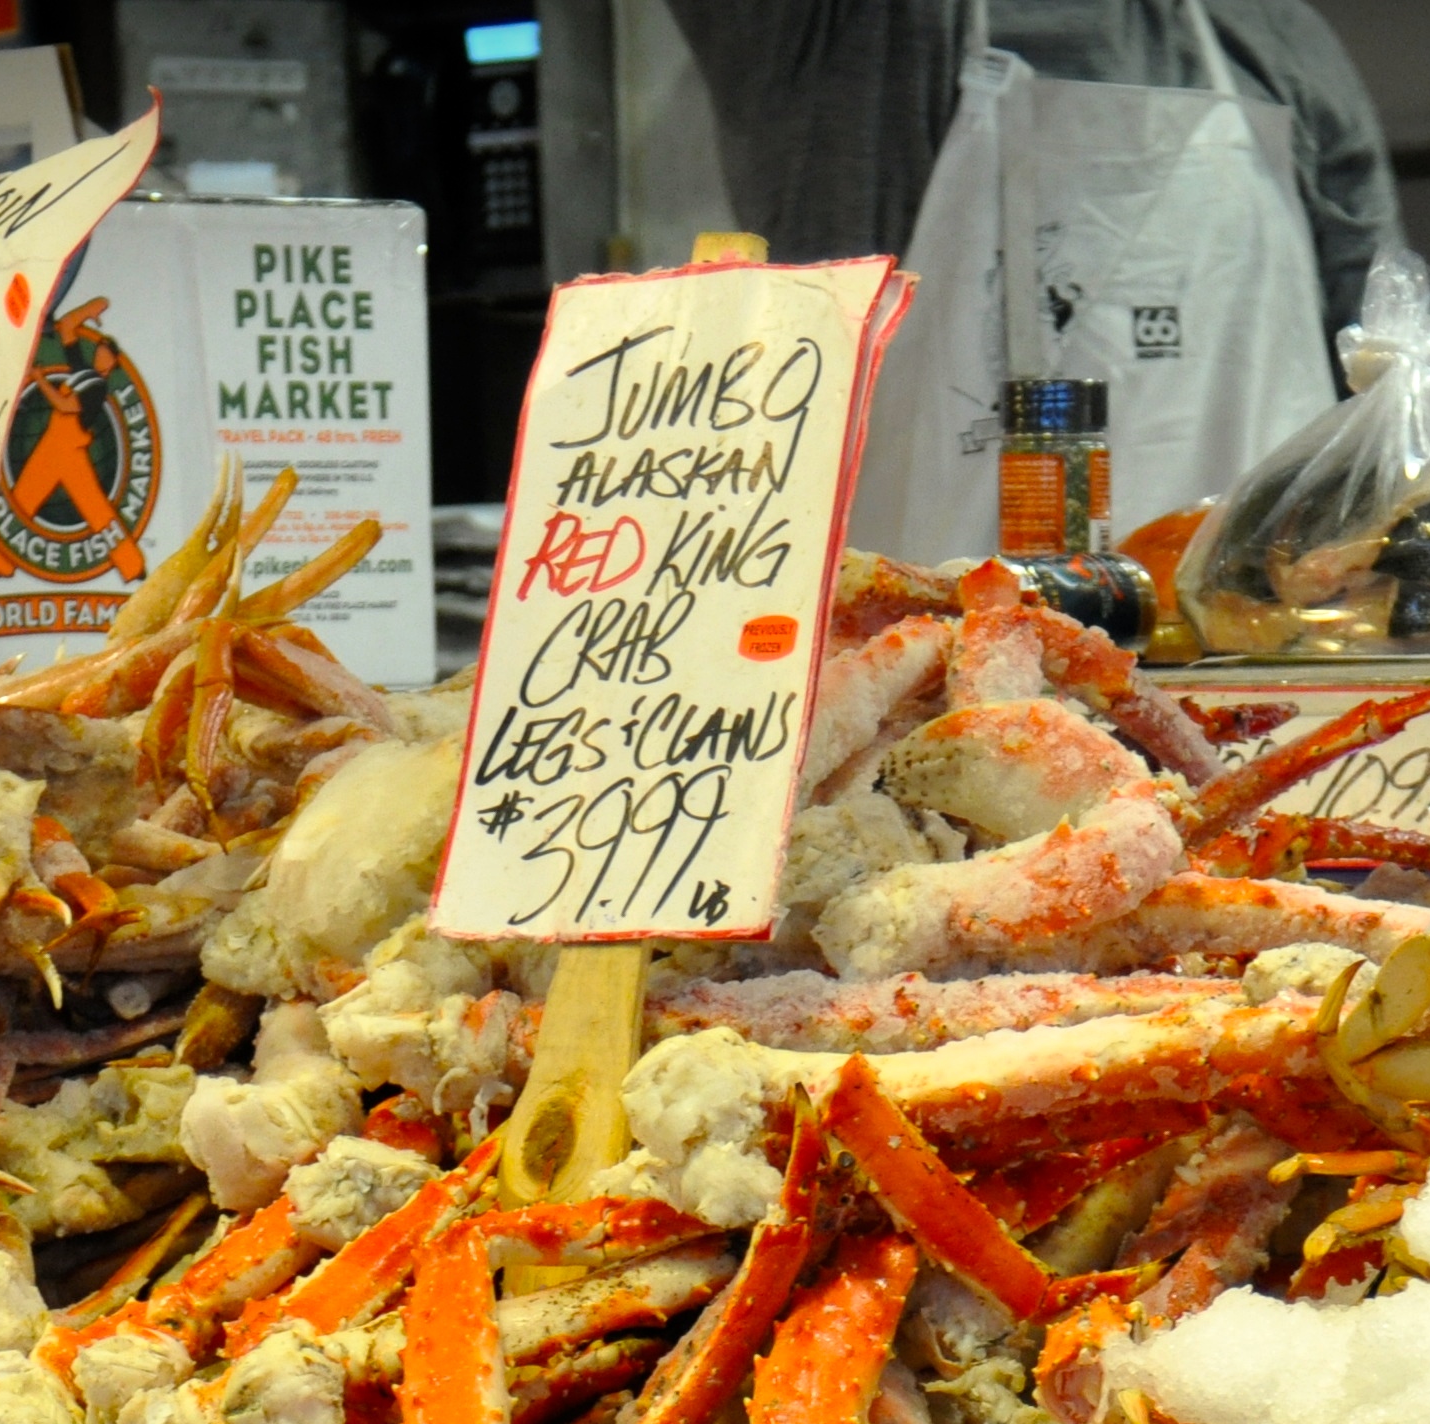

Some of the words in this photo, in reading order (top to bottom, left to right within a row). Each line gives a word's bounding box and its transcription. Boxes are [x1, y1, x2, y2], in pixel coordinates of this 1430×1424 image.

[253, 243, 351, 284] PIKE
[235, 289, 373, 330] PLACE
[257, 335, 353, 375] FISH
[551, 325, 822, 465] JUMBO
[218, 380, 394, 420] MARKET
[69, 522, 125, 567] FISH
[120, 384, 153, 521] MARKET
[557, 441, 790, 508] ALASKAN
[517, 508, 646, 602] RED
[646, 502, 792, 593] KING
[64, 600, 120, 626] FAM
[520, 584, 695, 707] CRAB
[475, 706, 608, 789] LEGS
[632, 690, 796, 772] CLAWS
[478, 766, 730, 927] $39.99
